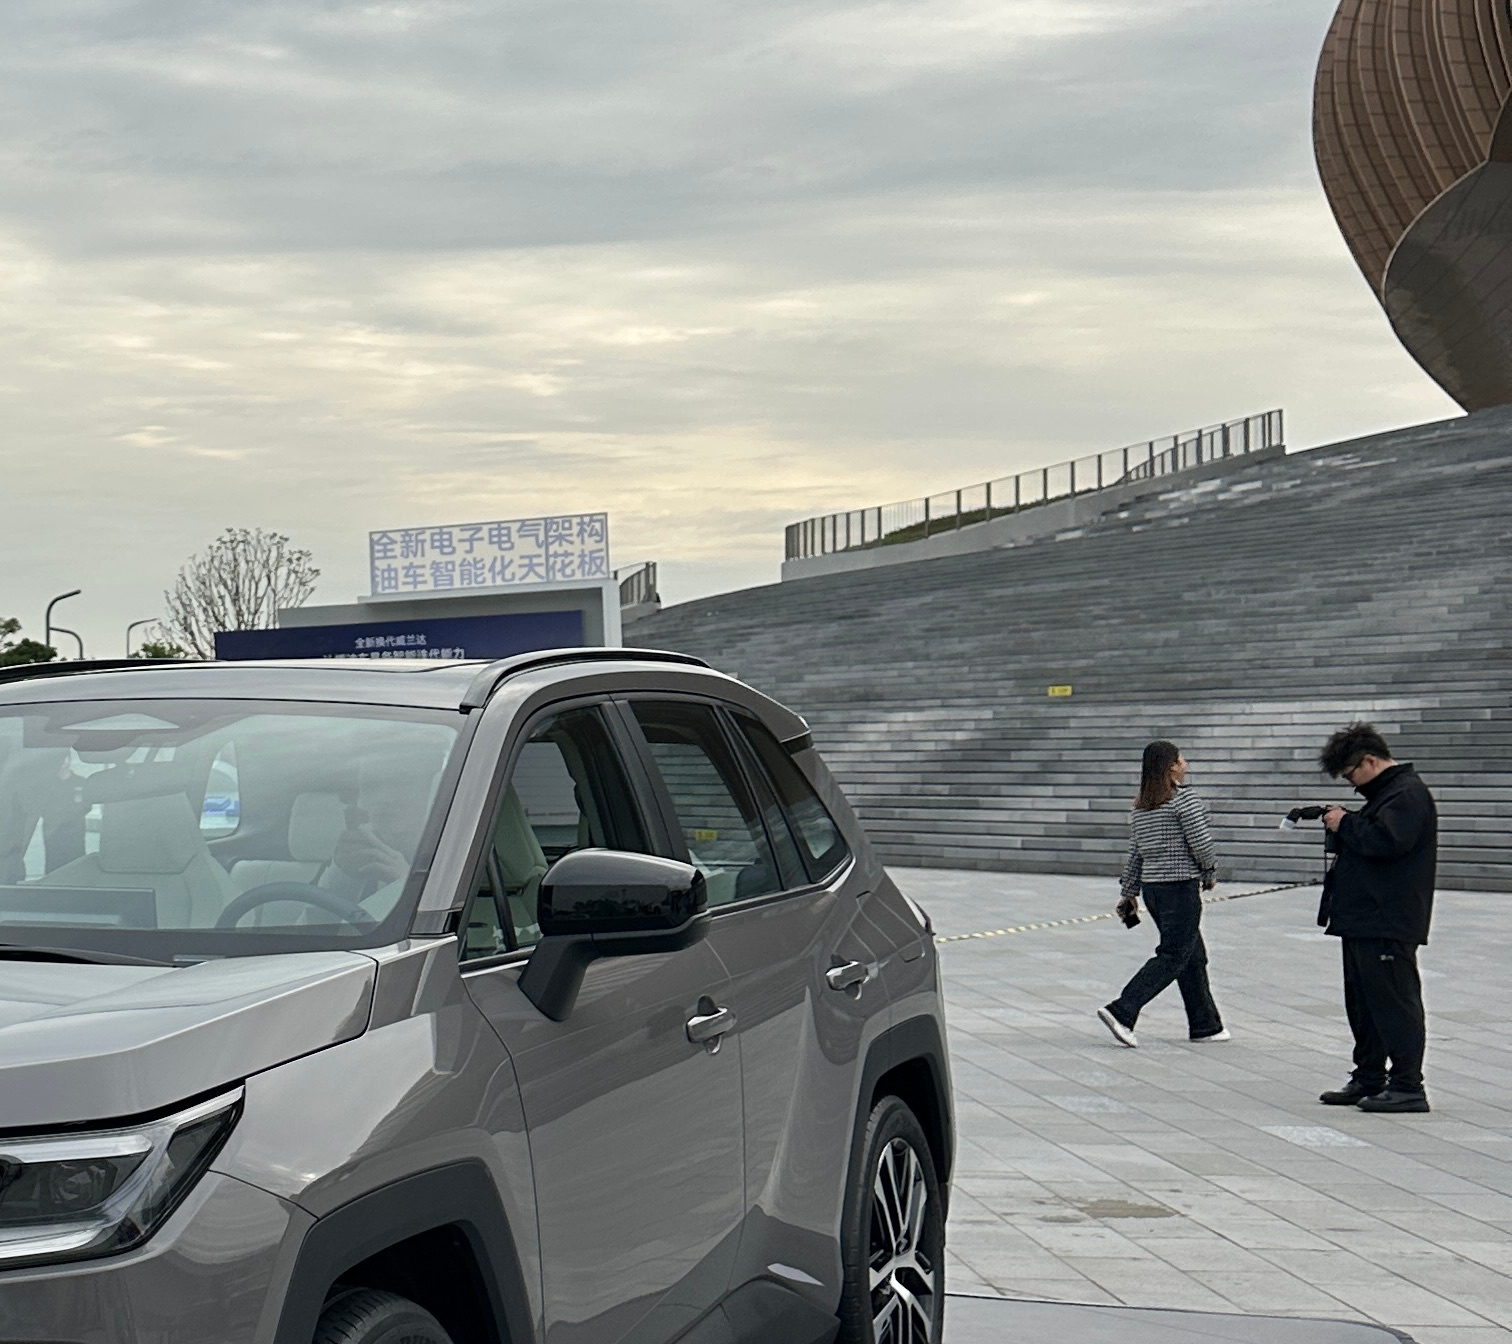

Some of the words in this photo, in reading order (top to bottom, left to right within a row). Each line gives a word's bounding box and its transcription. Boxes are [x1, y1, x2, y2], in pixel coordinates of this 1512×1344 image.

[373, 517, 606, 560] 全新电子电气架构
[374, 549, 607, 592] 油车智能化天花板
